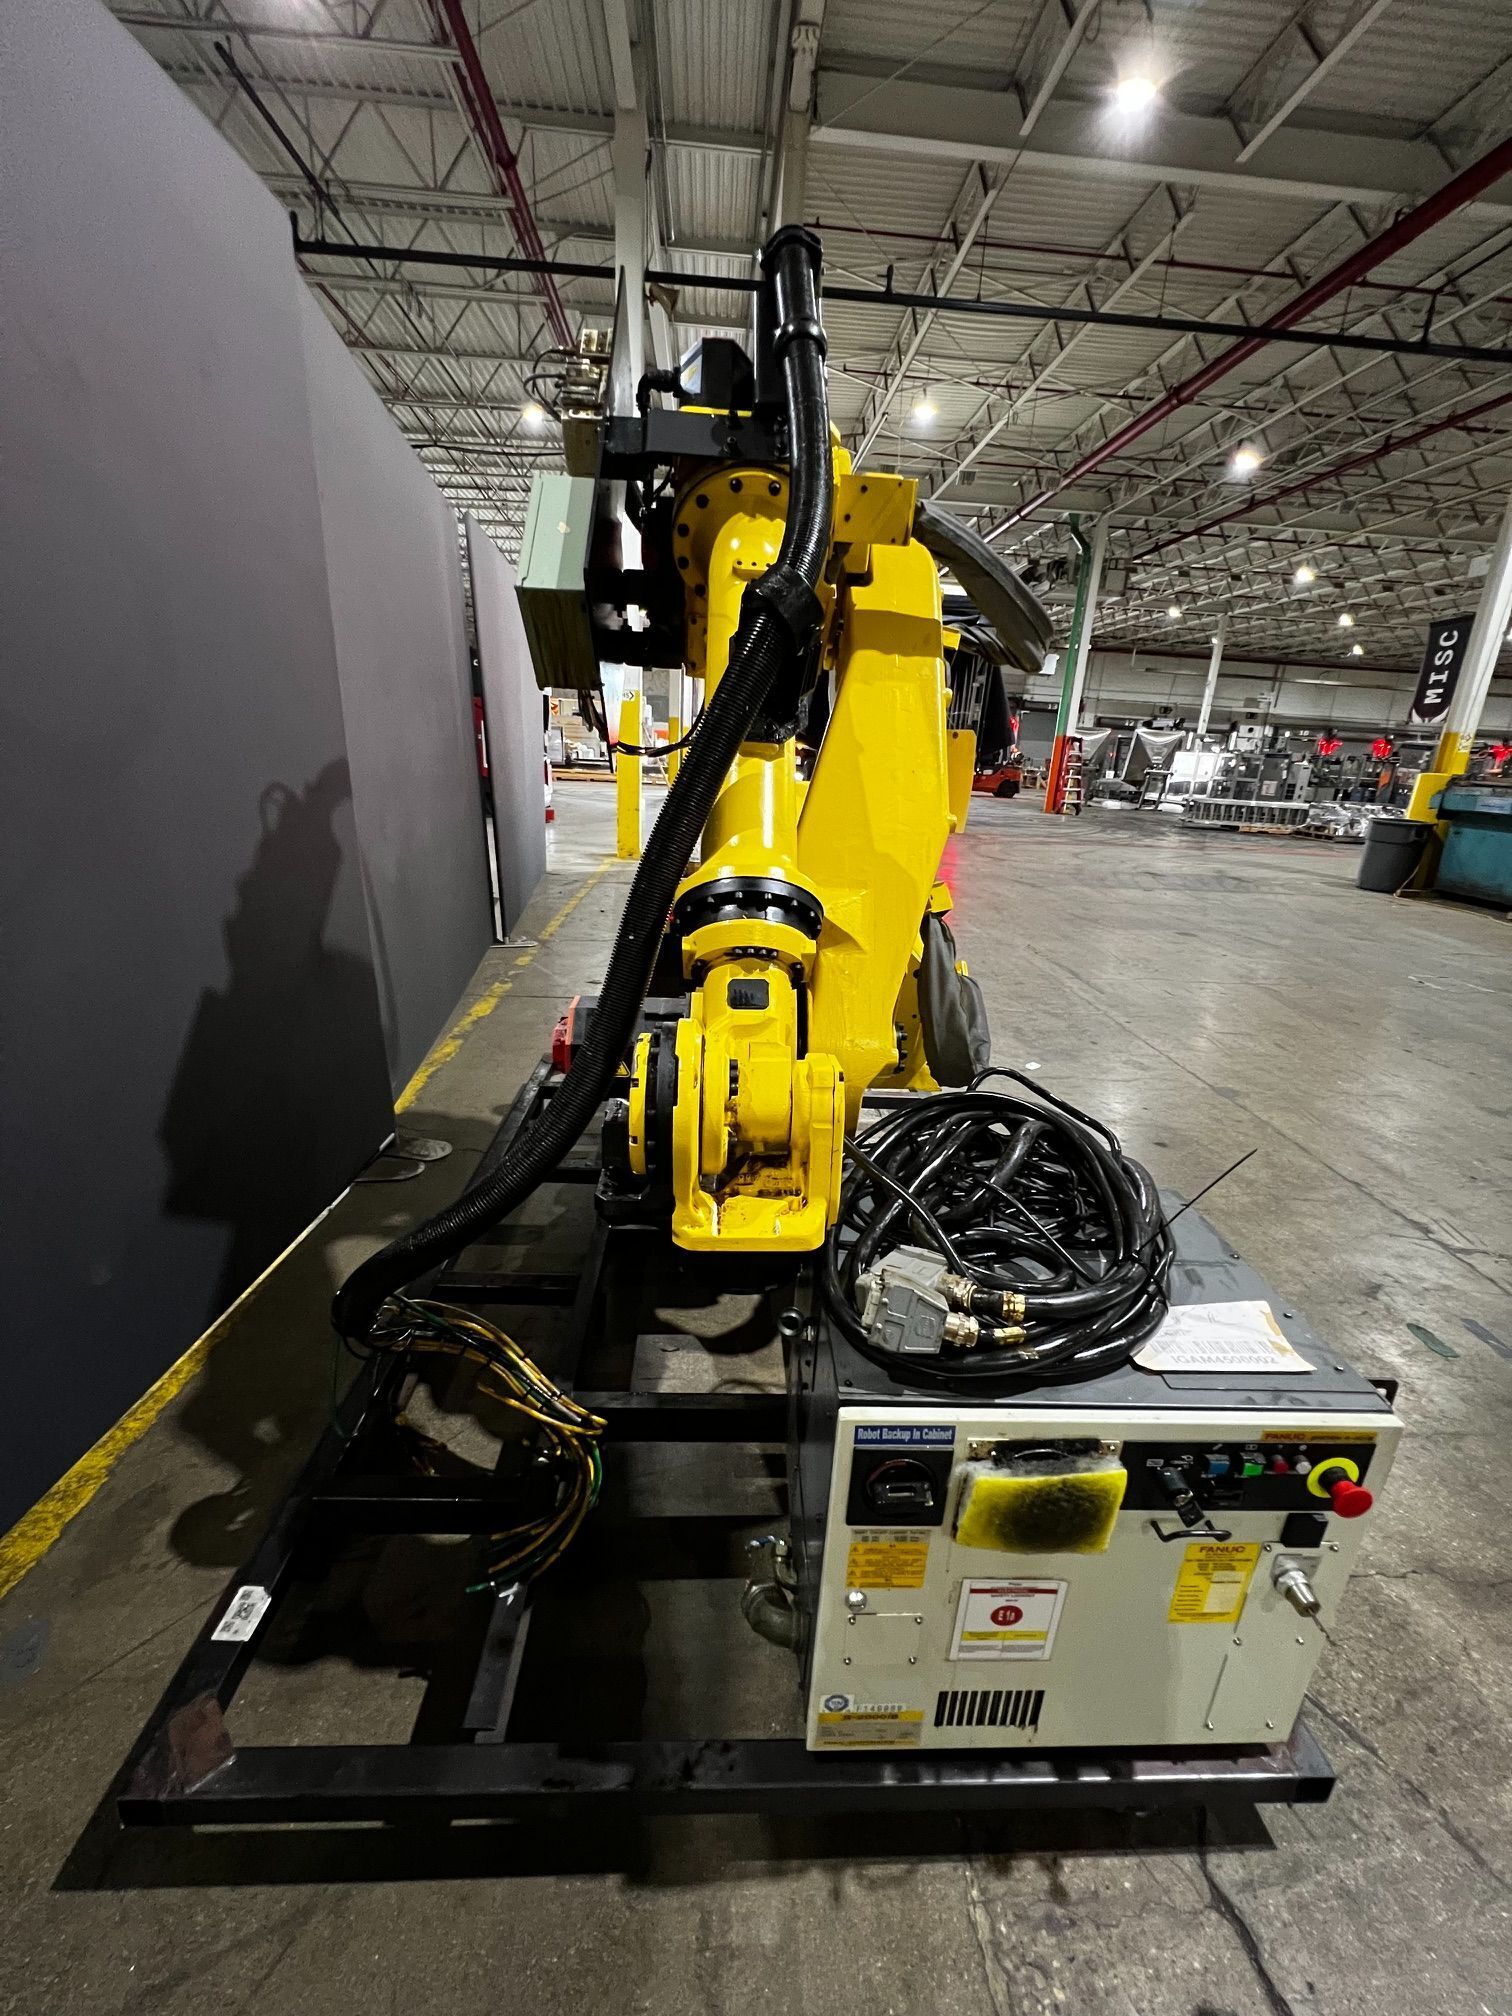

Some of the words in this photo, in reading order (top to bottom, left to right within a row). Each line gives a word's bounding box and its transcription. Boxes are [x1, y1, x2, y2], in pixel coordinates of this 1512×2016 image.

[1423, 629, 1459, 704] MISC
[857, 1428, 881, 1440] Robot
[882, 1428, 911, 1442] Backup
[912, 1428, 921, 1440] In
[922, 1428, 953, 1440] Cabinet
[1199, 1545, 1247, 1553] FANUC
